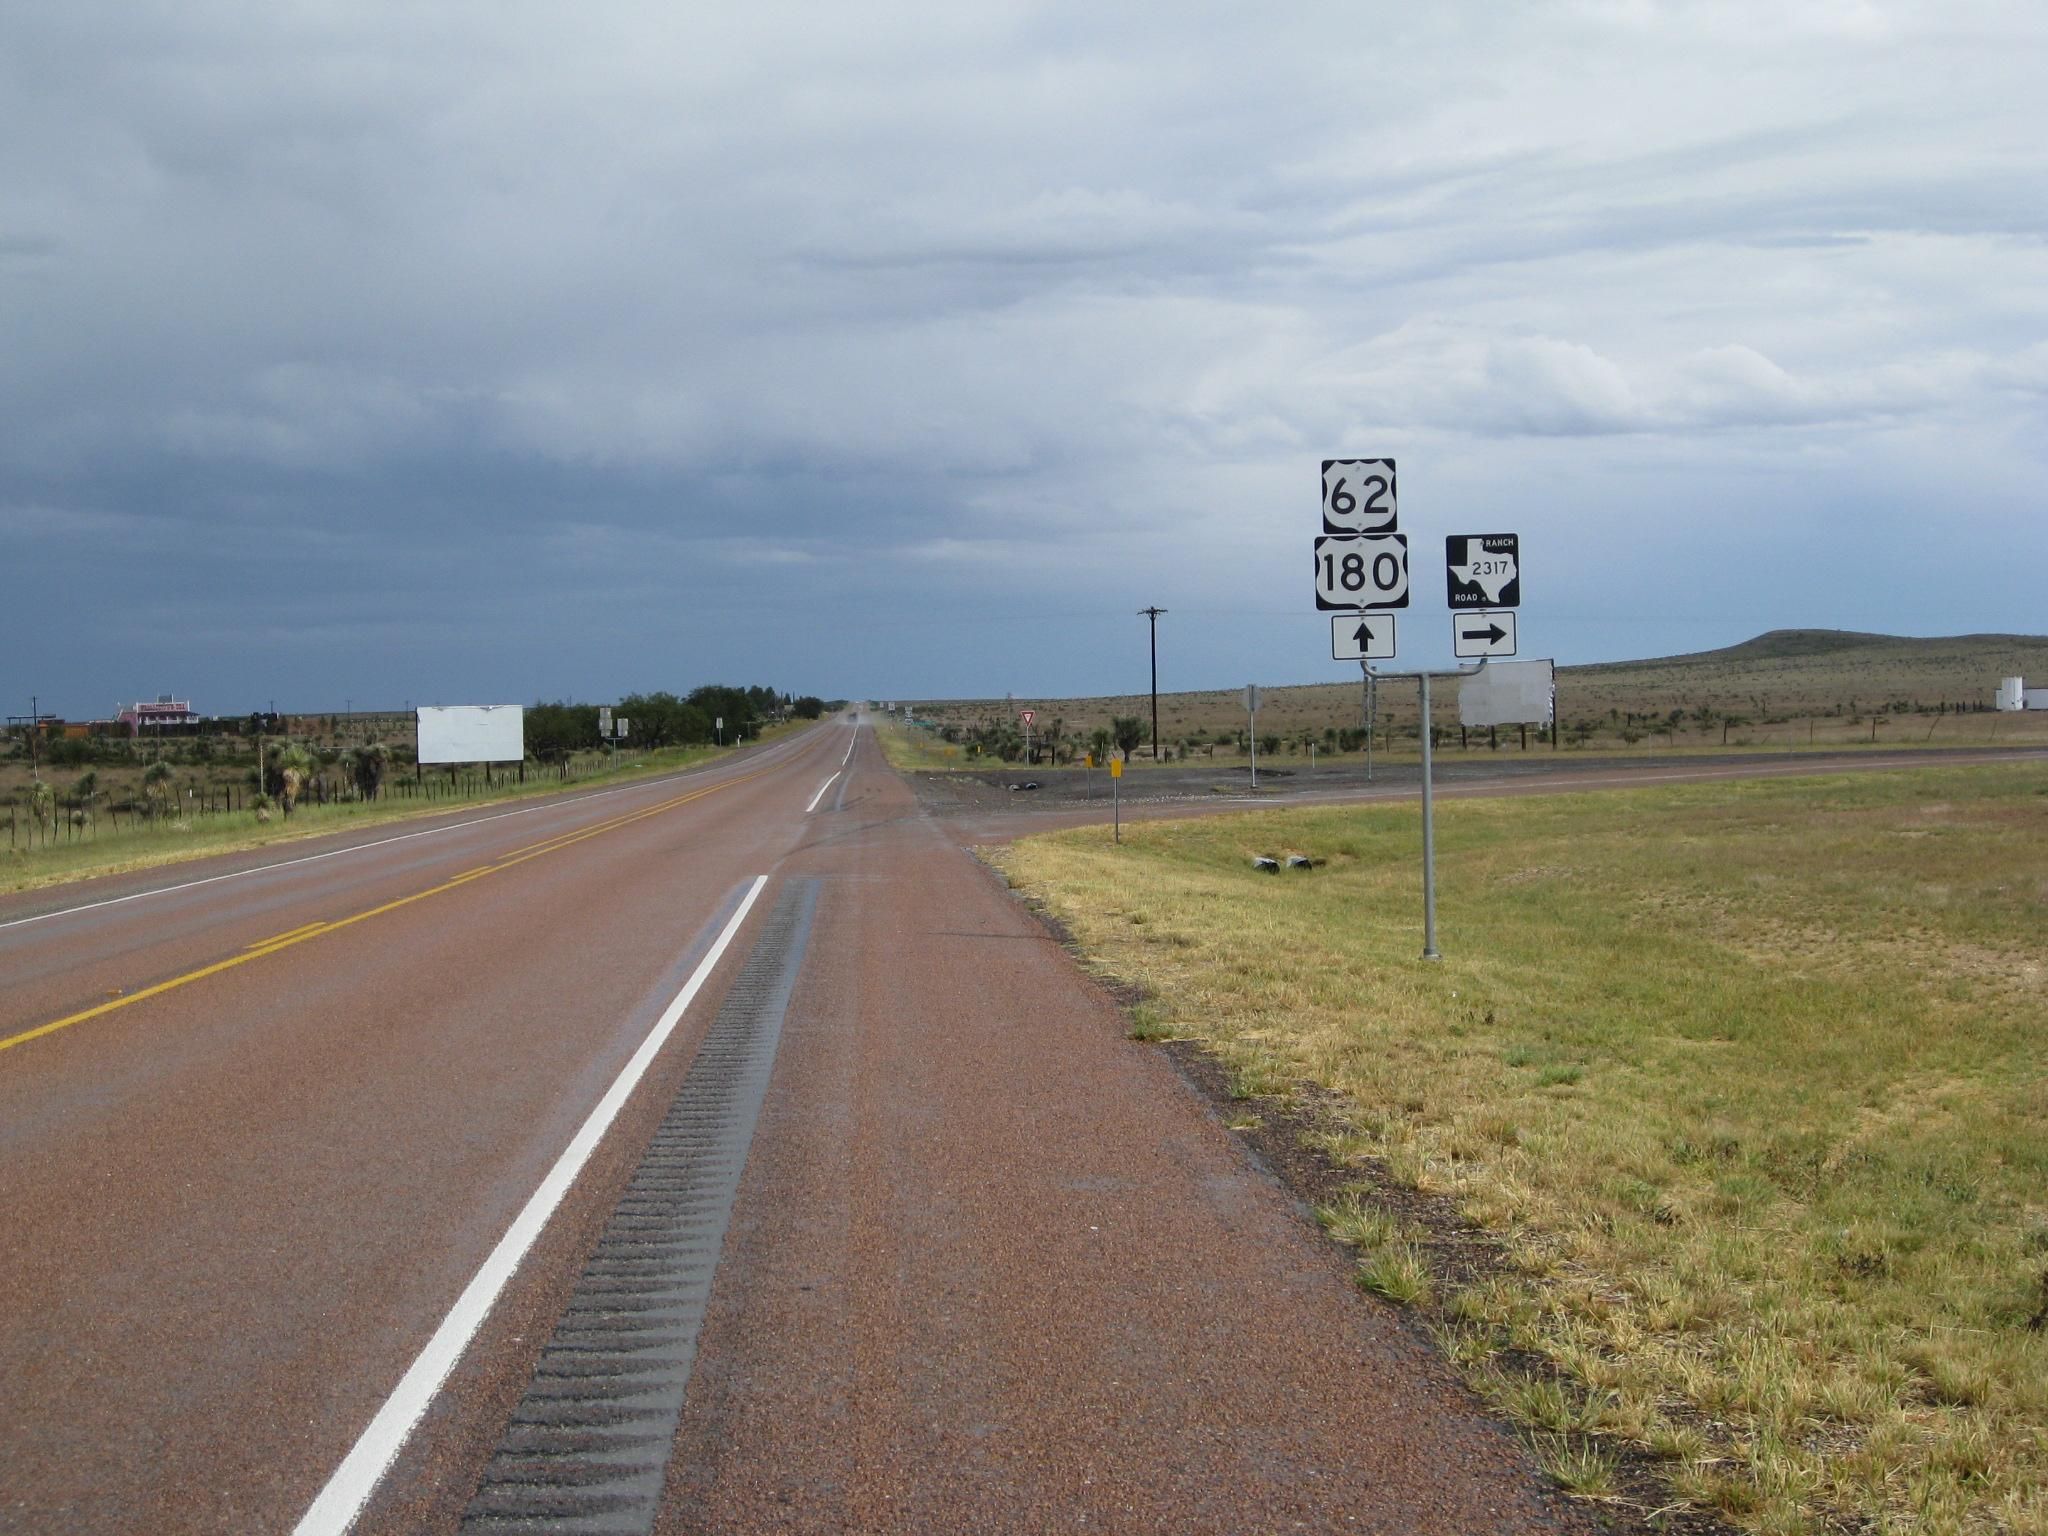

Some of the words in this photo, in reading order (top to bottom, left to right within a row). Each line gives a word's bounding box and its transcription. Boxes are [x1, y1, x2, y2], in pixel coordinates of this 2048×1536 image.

[1331, 475, 1389, 515] 62
[1485, 538, 1514, 547] RANCH
[1324, 552, 1399, 591] 180
[1472, 561, 1508, 575] 2317
[1455, 593, 1478, 602] ROAD
